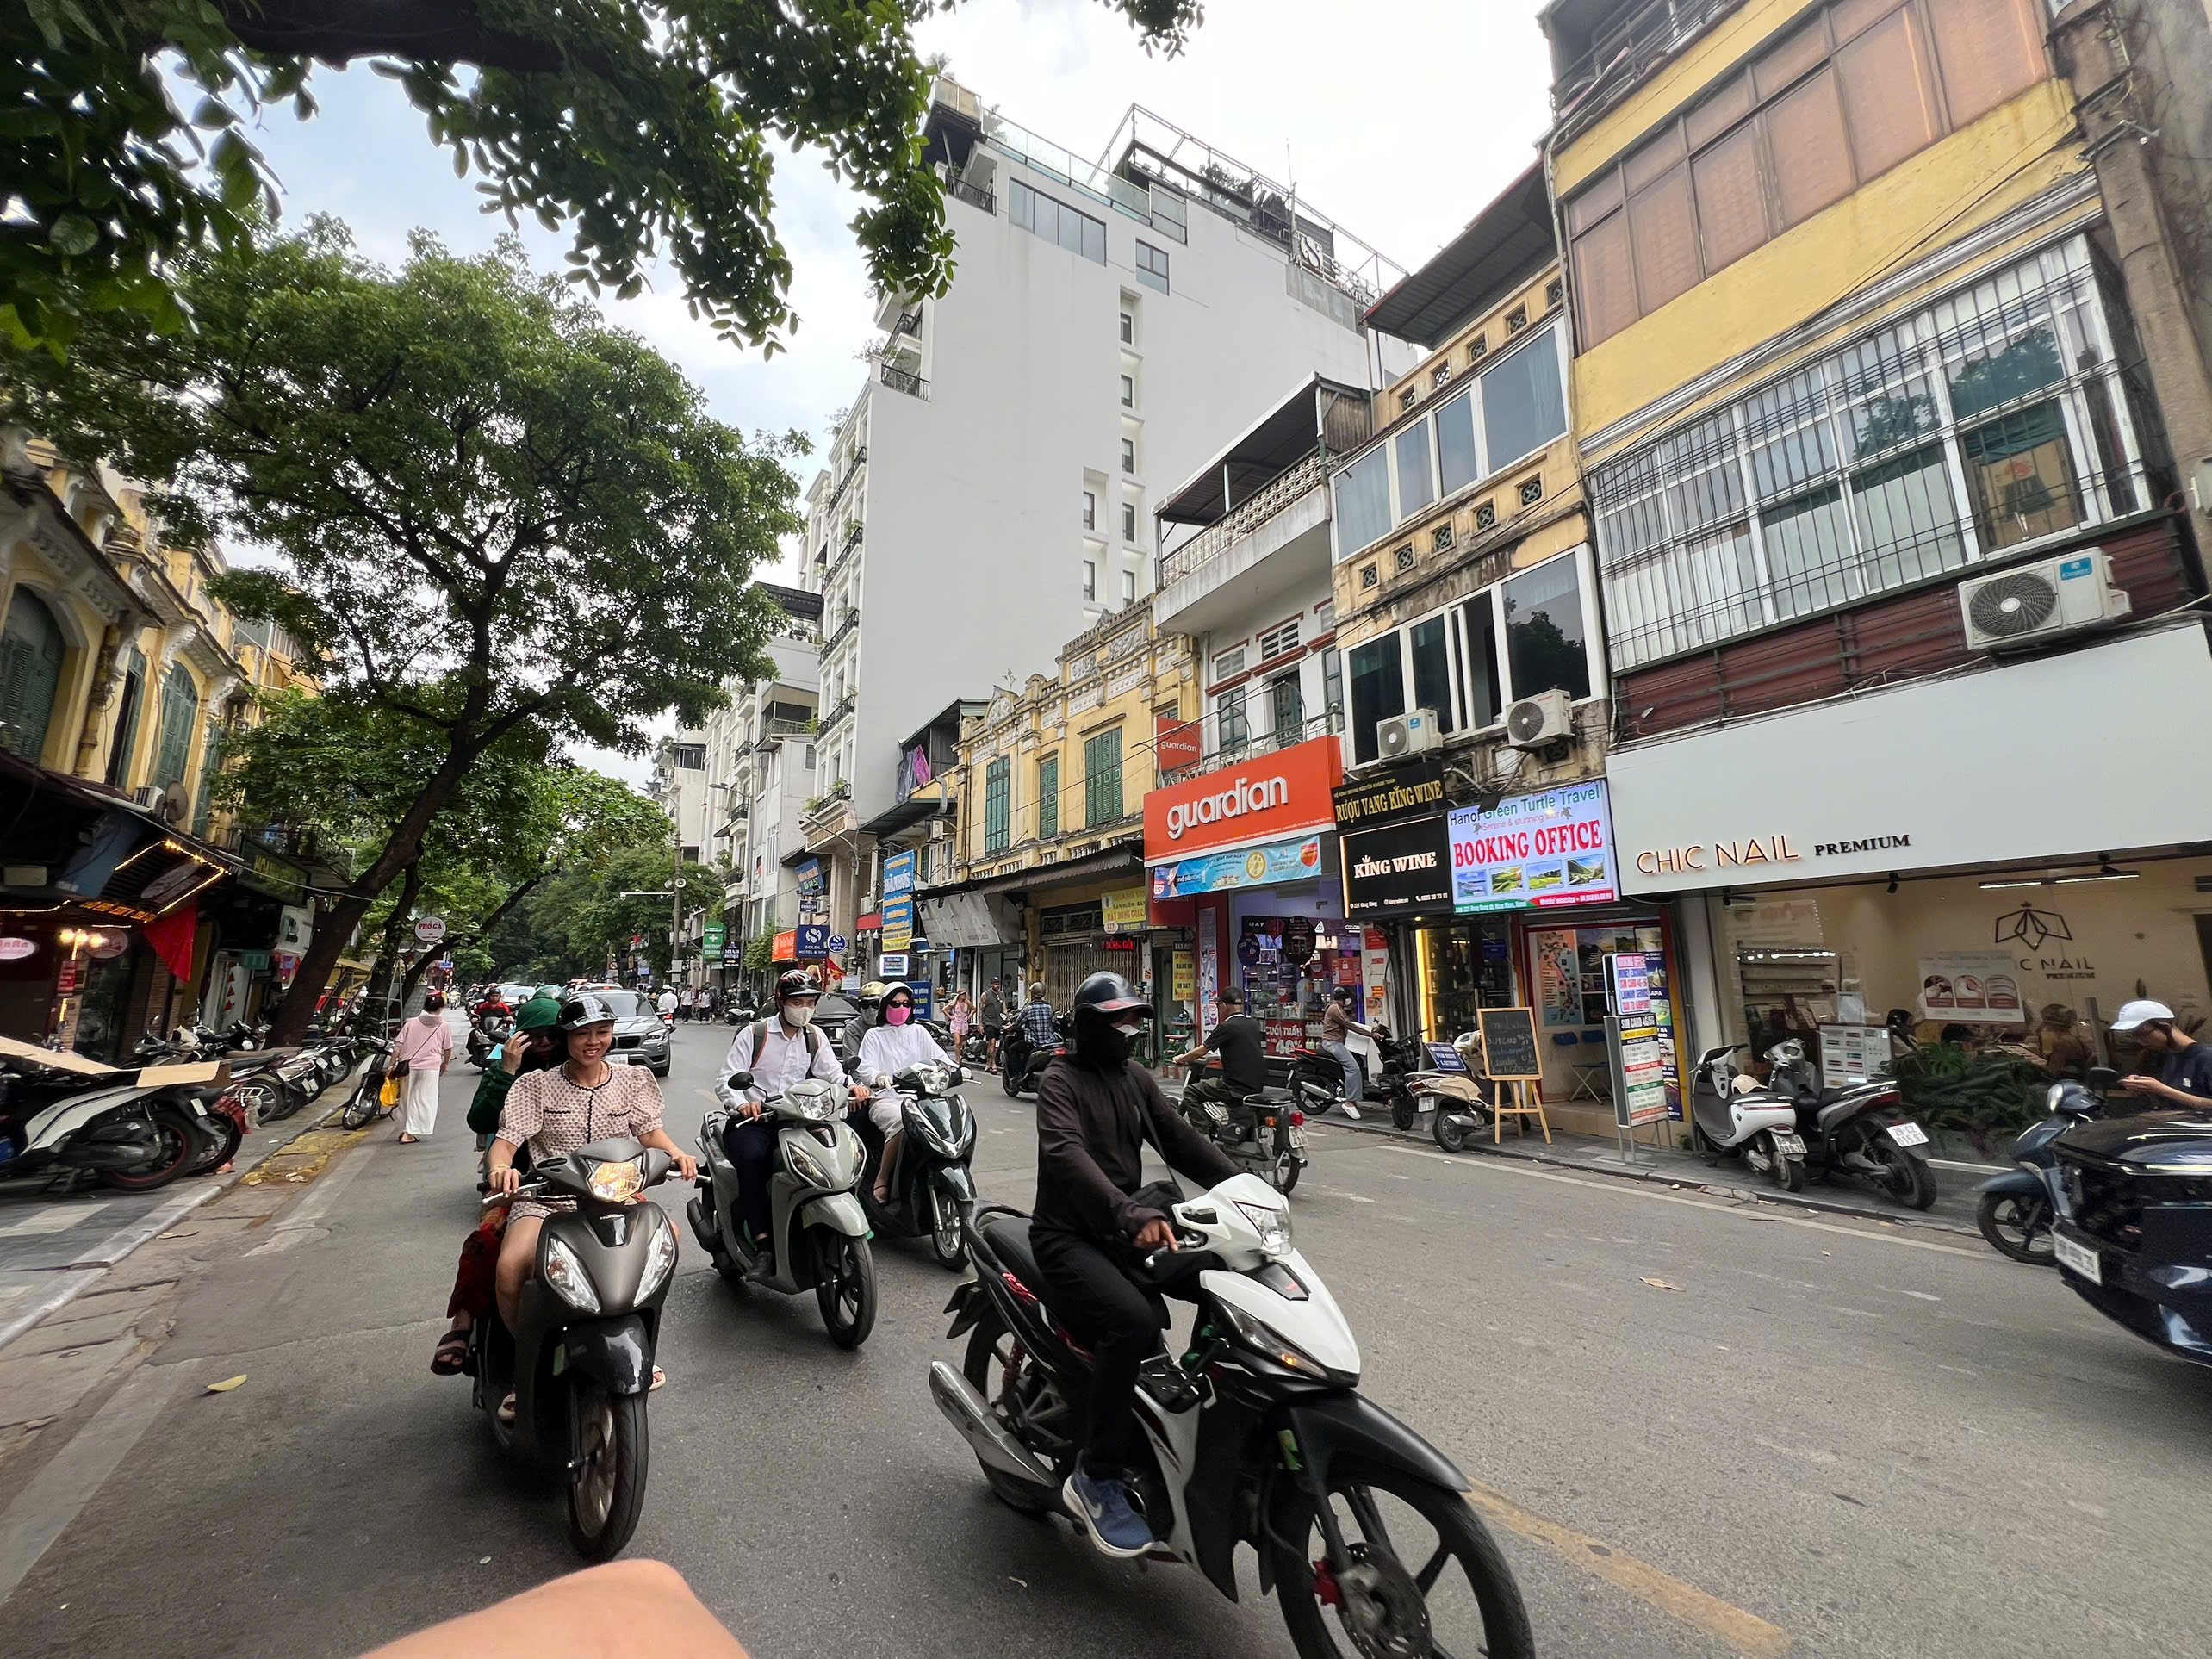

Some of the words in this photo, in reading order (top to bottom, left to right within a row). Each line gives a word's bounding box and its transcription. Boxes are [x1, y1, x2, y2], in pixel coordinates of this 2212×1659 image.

[1160, 740, 1197, 753] guardian
[1167, 776, 1289, 840] guardian
[1361, 793, 1389, 816] VANG
[1389, 789, 1414, 810] KING
[1413, 780, 1443, 804] WINE
[1483, 804, 1518, 820] Green
[1520, 794, 1556, 813] Turtle
[1559, 784, 1600, 805] Travel
[1482, 819, 1507, 831] Serene
[1514, 814, 1544, 827] stunning
[1454, 832, 1530, 867] BOOKING
[1534, 819, 1603, 856] OFFICE
[1637, 845, 1703, 874] CHIC
[1715, 835, 1799, 867] NAIL
[1814, 834, 1911, 856] PREMIUM
[1353, 859, 1391, 879] KING
[1391, 851, 1437, 873] WINE
[2040, 957, 2095, 970] NAIL
[1621, 1018, 1631, 1029] SIM
[1631, 1016, 1643, 1028] CARD
